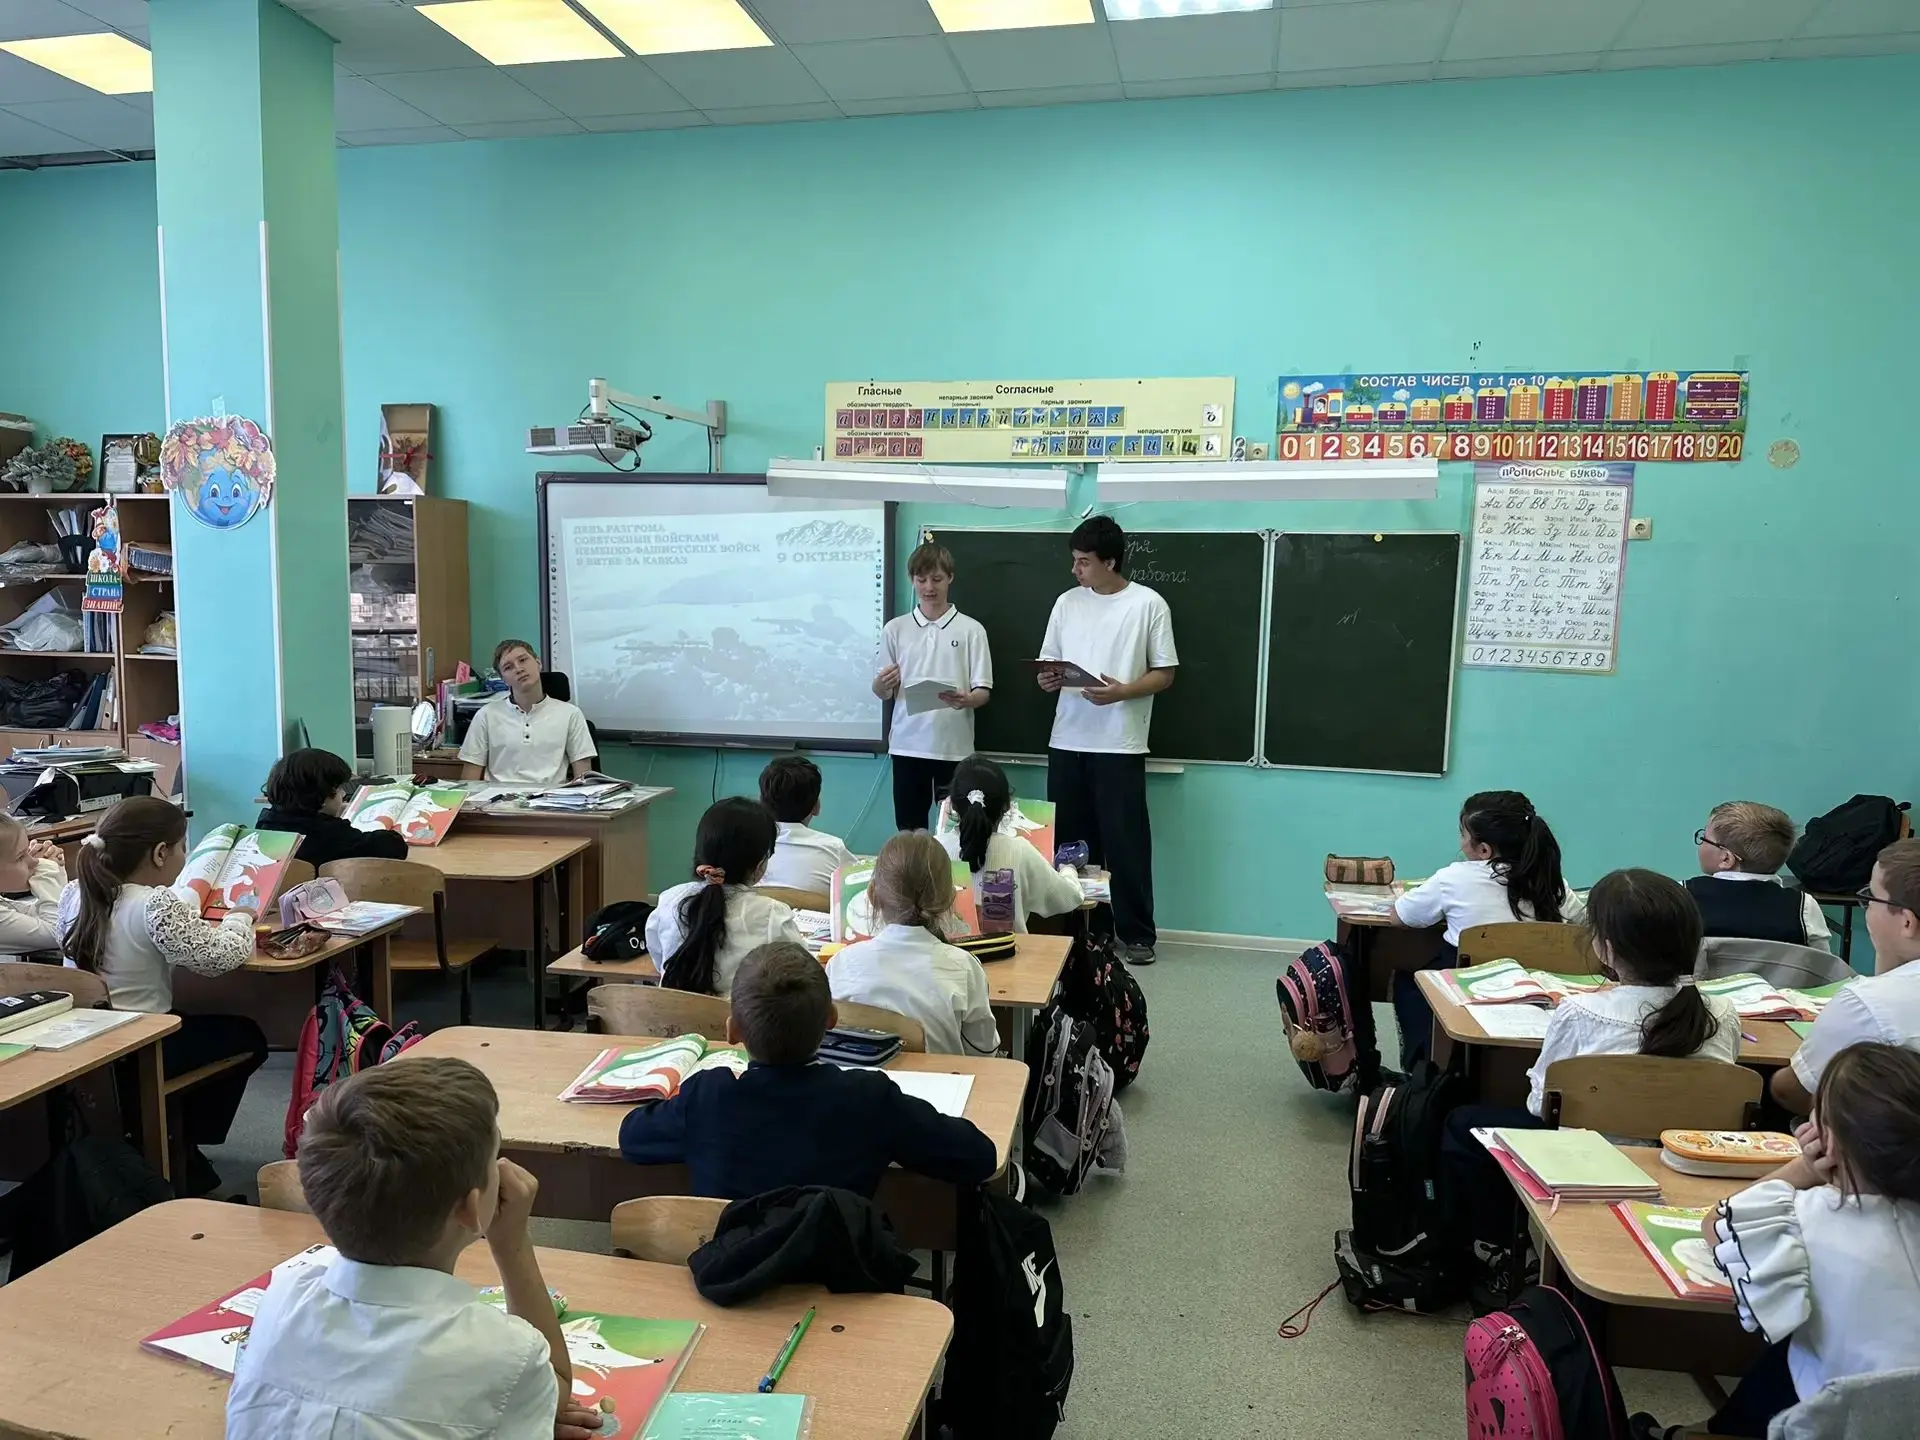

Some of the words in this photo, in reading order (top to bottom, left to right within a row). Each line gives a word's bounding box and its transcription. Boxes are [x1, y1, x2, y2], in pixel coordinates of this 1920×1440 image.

[1360, 376, 1417, 388] СОСТАВ
[1421, 375, 1470, 387] ЧИСЕЛ
[1479, 378, 1494, 386] от
[1497, 376, 1504, 386] 1
[1508, 377, 1526, 388] до
[1529, 375, 1545, 386] 10
[858, 386, 902, 396] Гласные
[996, 384, 1054, 394] Согласные
[858, 414, 867, 425] о
[874, 413, 885, 428] у
[908, 414, 920, 425] ы
[943, 415, 955, 425] м
[980, 414, 991, 428] р
[1018, 409, 1028, 424] б
[1036, 412, 1045, 423] в
[1089, 412, 1103, 423] ж
[1110, 413, 1119, 423] з
[1170, 428, 1193, 436] глухие
[839, 443, 849, 454] я
[871, 443, 886, 454] ю
[892, 443, 901, 454] е
[909, 443, 919, 454] и
[1032, 438, 1046, 456] ф
[1054, 442, 1063, 452] к
[1068, 439, 1083, 450] т
[1088, 438, 1103, 449] ш
[1128, 441, 1139, 452] х
[1166, 441, 1174, 451] ч
[1182, 441, 1197, 455] щ
[1283, 436, 1298, 458] 0
[1305, 437, 1316, 458] 1
[1324, 436, 1341, 457] 2
[1345, 436, 1361, 457] 3
[1364, 436, 1381, 457] 4
[1387, 436, 1403, 457] 5
[1409, 436, 1425, 457] 6
[1432, 436, 1448, 457] 7
[1454, 436, 1470, 457] 8
[1474, 436, 1490, 457] 9
[1493, 436, 1513, 457] 10
[1516, 436, 1533, 458] 11
[1537, 436, 1557, 458] 12
[1560, 436, 1581, 458] 13
[1583, 436, 1604, 458] 14
[1606, 436, 1627, 458] 15
[1628, 436, 1649, 458] 16
[1652, 436, 1672, 458] 17
[1673, 435, 1694, 457] 18
[1696, 436, 1717, 457] 19
[1718, 436, 1742, 458] 20
[1502, 467, 1566, 479] ПРОПИСНЫЕ
[1570, 469, 1606, 479] БУКВЫ
[573, 525, 605, 535] ДЕНЬ
[605, 524, 666, 534] РАЗГРОМА
[654, 532, 719, 544] ВОЙСКАМИ
[575, 545, 718, 557] НЕМЕЦКО-ФАШИСТСКИХ
[720, 542, 761, 553] ВОЙСК
[625, 557, 640, 565] ЗА
[643, 556, 688, 565] КАВКАЗ
[777, 552, 786, 564] 9
[792, 550, 876, 563] ОКТЯБРЯ
[91, 587, 120, 597] СТРАНА
[1472, 648, 1483, 661] 0
[1488, 648, 1497, 660] 1
[1500, 648, 1512, 661] 2
[1514, 649, 1523, 663] 3
[1527, 650, 1538, 663] 4
[1539, 651, 1551, 664] 5
[1552, 651, 1563, 664] 6
[1567, 652, 1578, 664] 7
[1580, 653, 1592, 666] 8
[1594, 653, 1605, 666] 9
